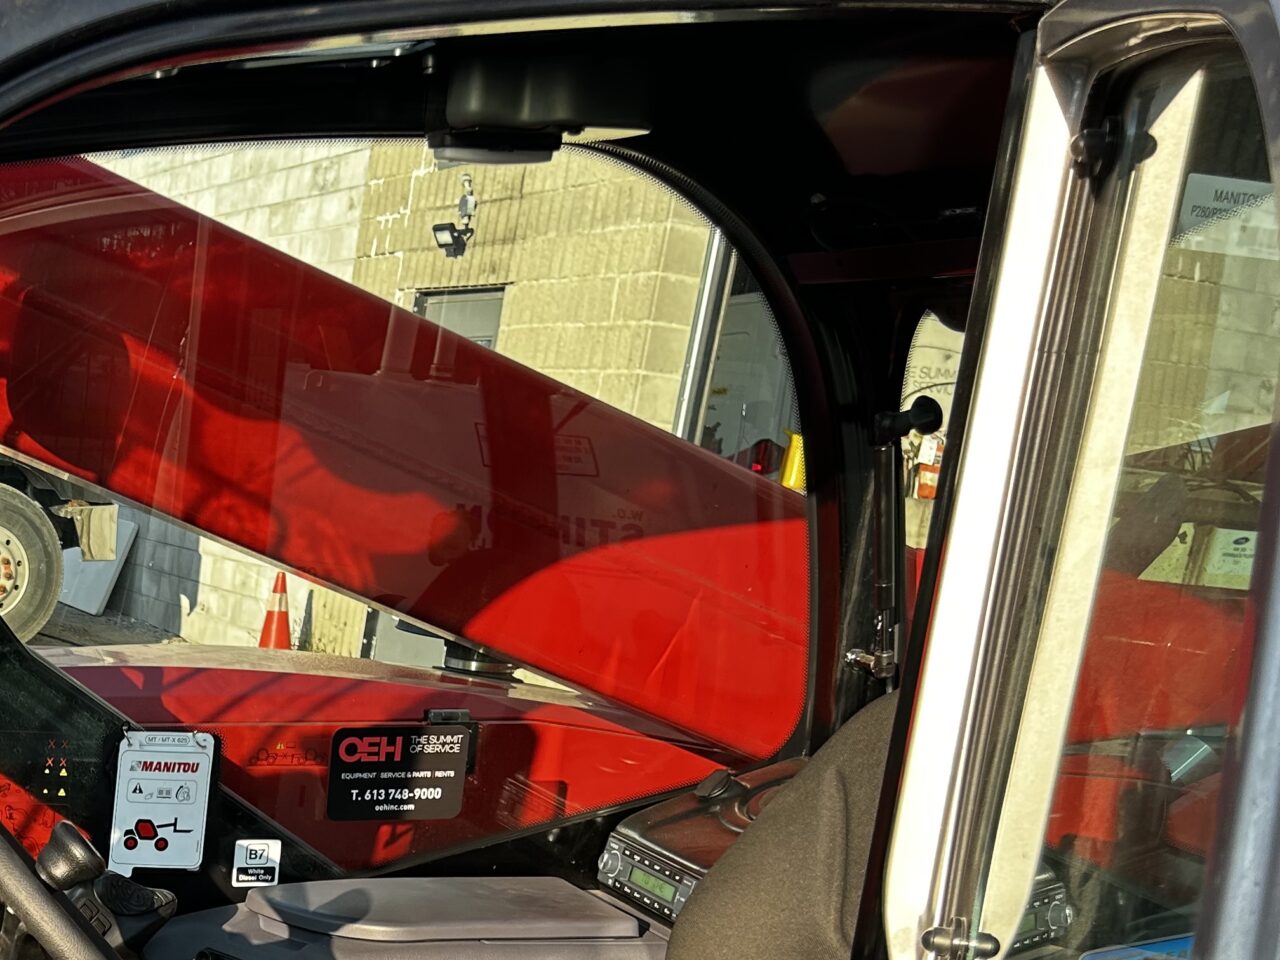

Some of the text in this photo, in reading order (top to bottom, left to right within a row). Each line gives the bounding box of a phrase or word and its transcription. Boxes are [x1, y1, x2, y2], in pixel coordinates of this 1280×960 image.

[410, 734, 464, 744] THE SUMMIT
[338, 736, 403, 762] OEH
[409, 744, 460, 753] OF SERVICE
[140, 760, 200, 773] MANITOU
[380, 771, 406, 779] SERVICE
[412, 770, 431, 778] PARTS
[351, 787, 442, 801] T. 613 748-9000
[374, 803, 415, 811] oehinc.com
[249, 848, 266, 860] B7
